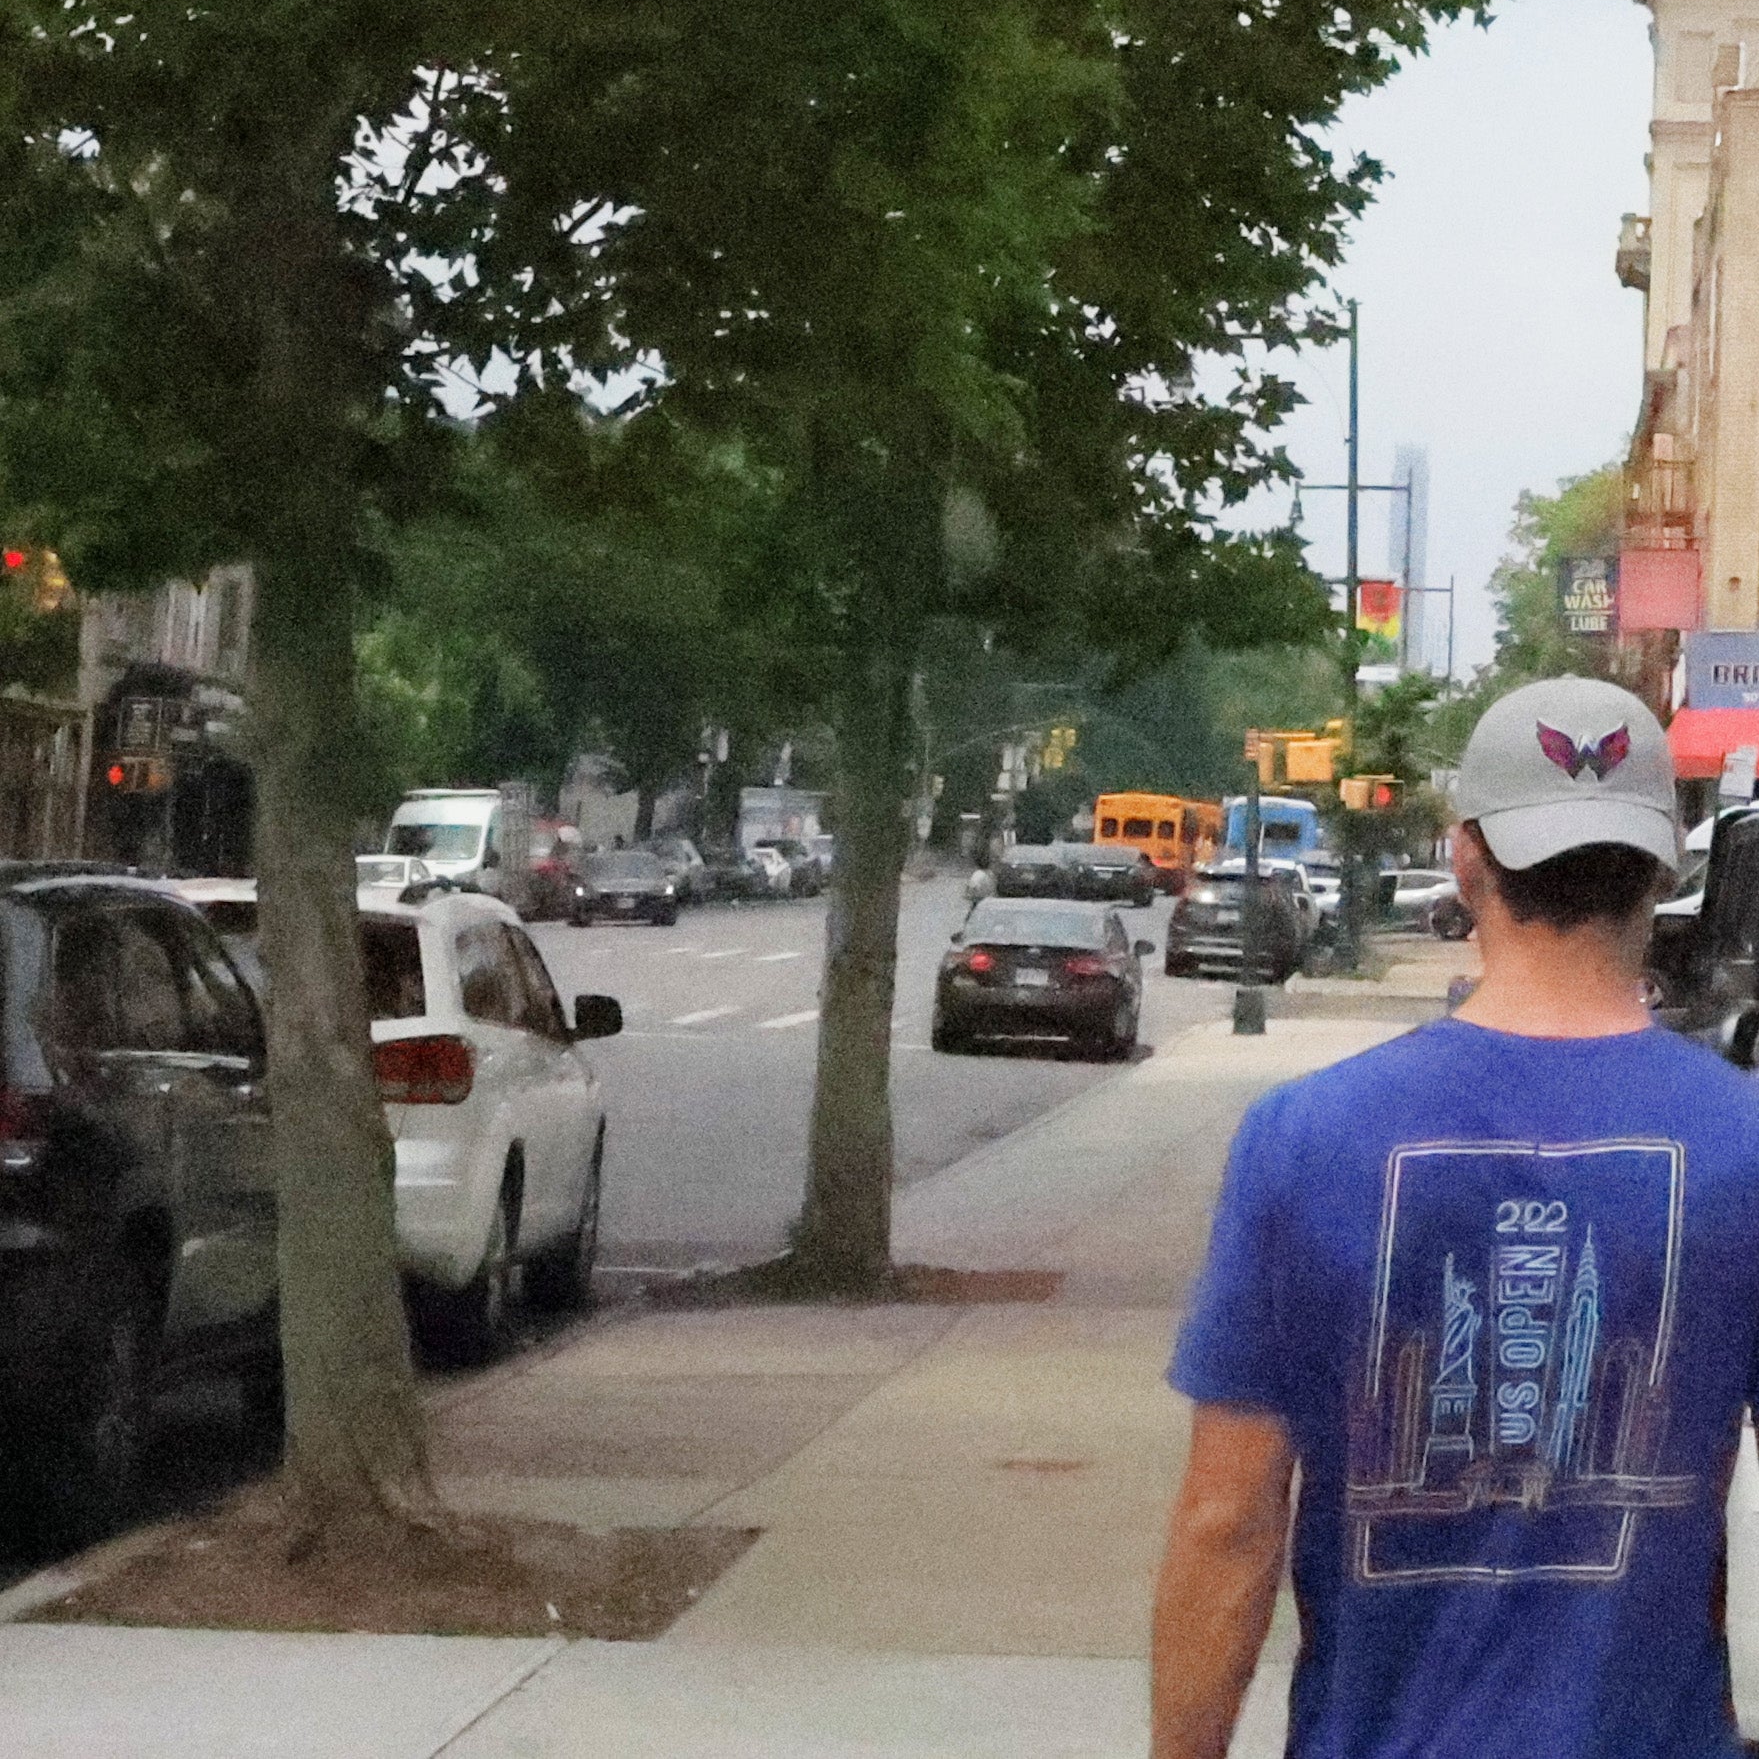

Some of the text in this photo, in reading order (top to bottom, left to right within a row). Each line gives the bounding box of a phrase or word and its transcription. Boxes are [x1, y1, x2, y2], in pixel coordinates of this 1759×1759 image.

[1572, 579, 1607, 594] CAR
[1498, 1244, 1561, 1445] US OPEN
